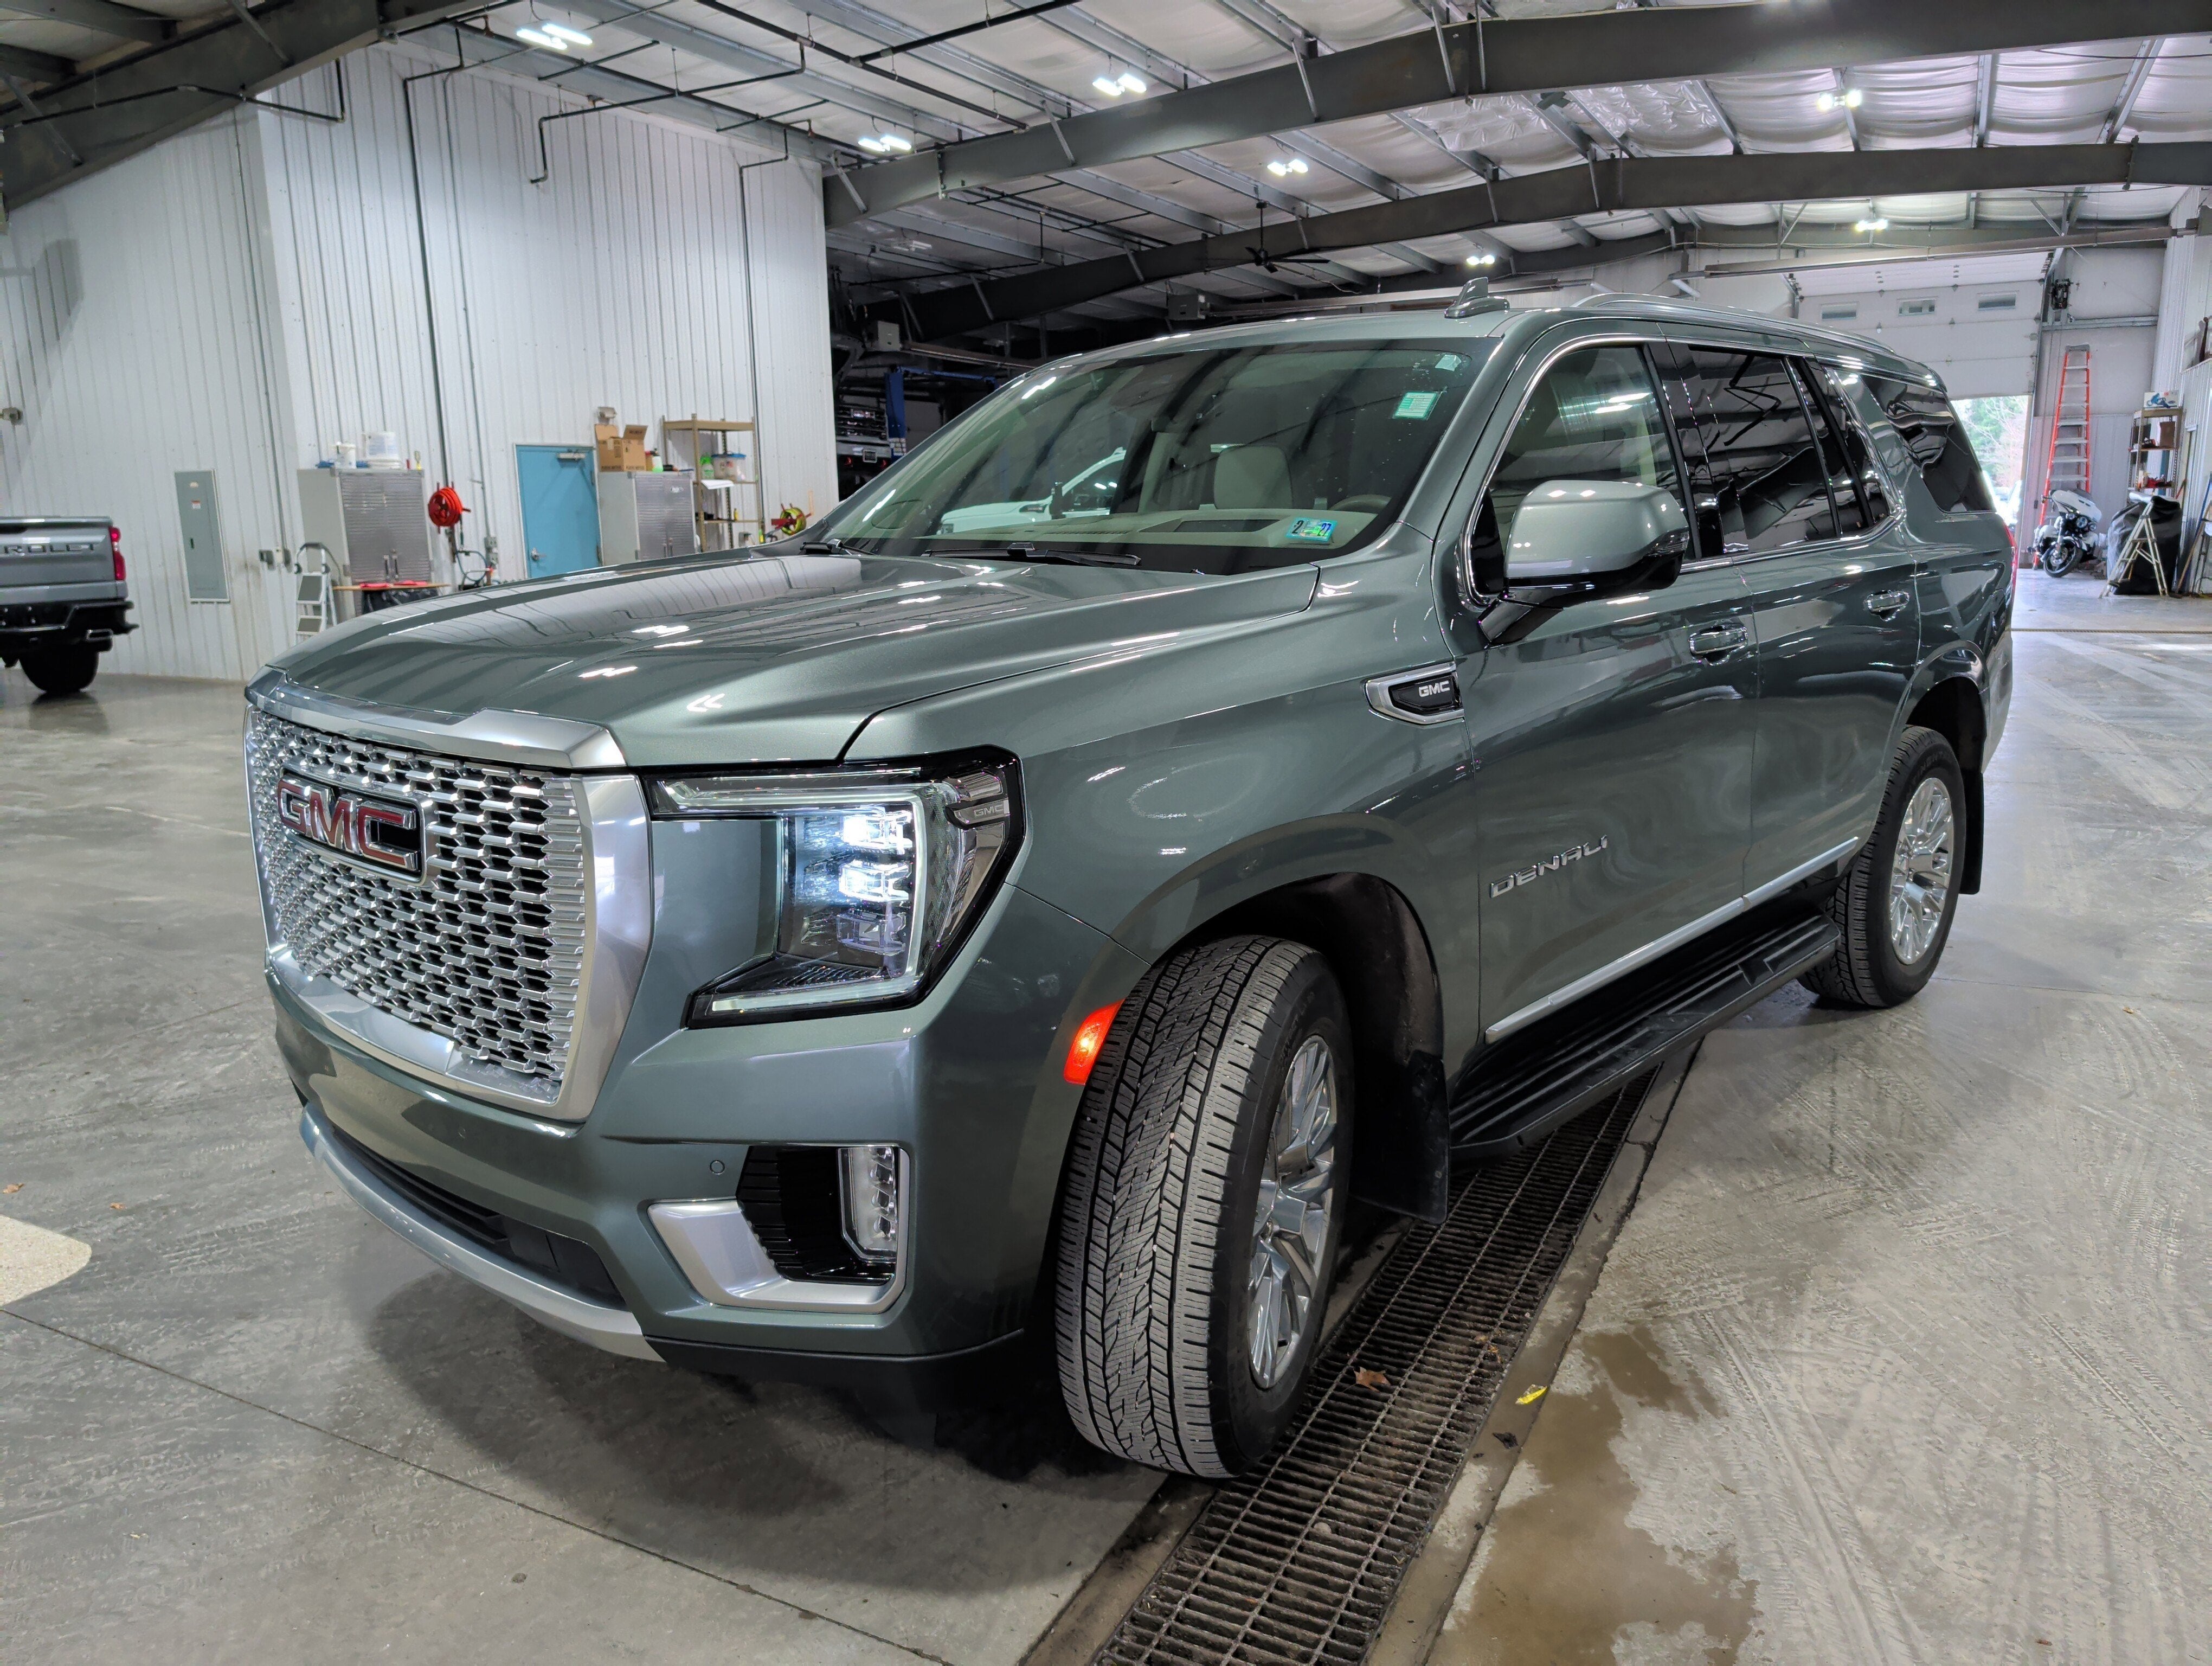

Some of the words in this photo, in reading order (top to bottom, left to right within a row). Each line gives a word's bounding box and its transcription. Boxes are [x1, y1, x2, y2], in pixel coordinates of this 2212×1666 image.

[1317, 523, 1332, 536] 27
[1418, 680, 1450, 697] GMC
[973, 804, 1004, 817] GMC
[278, 774, 421, 872] GMC
[1490, 834, 1607, 898] DENALI
